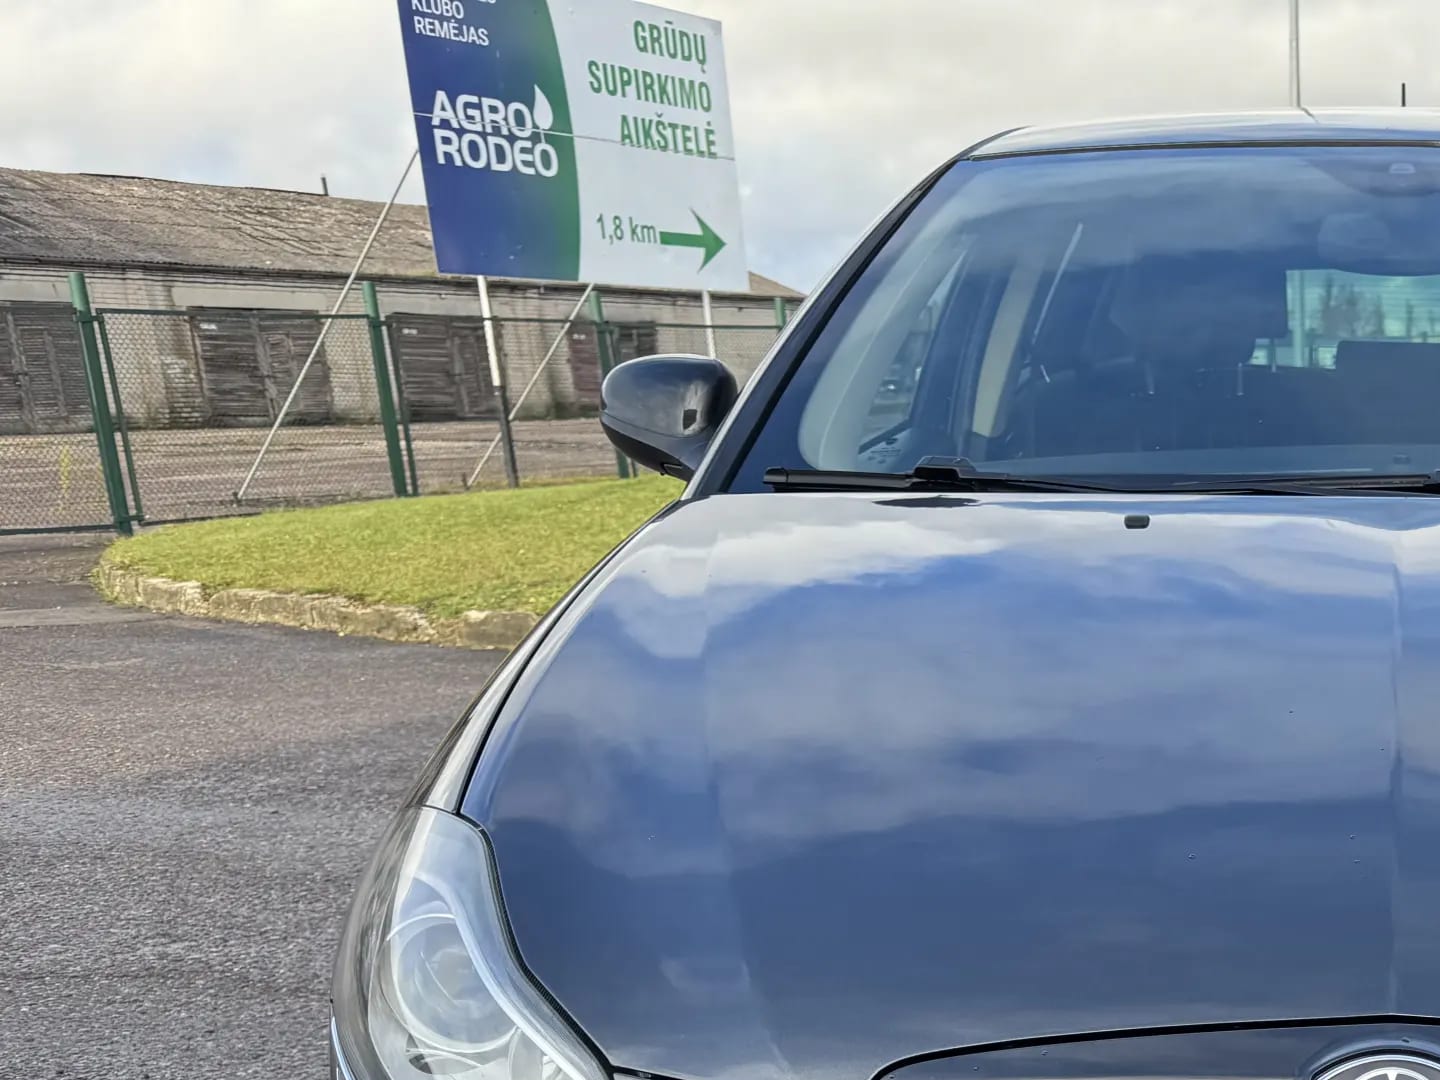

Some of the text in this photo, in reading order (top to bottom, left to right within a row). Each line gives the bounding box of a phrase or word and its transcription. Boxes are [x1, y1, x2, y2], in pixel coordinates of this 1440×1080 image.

[411, 0, 465, 19] KLUBO
[413, 15, 489, 46] REMĖJAS
[633, 19, 707, 74] GRŪDŲ
[587, 59, 712, 113] SUPIRKIMO
[431, 89, 533, 138] AGRO
[620, 111, 718, 160] AIKŠTELĖ
[433, 128, 559, 177] RODEO
[596, 213, 658, 246] 1,8 km
